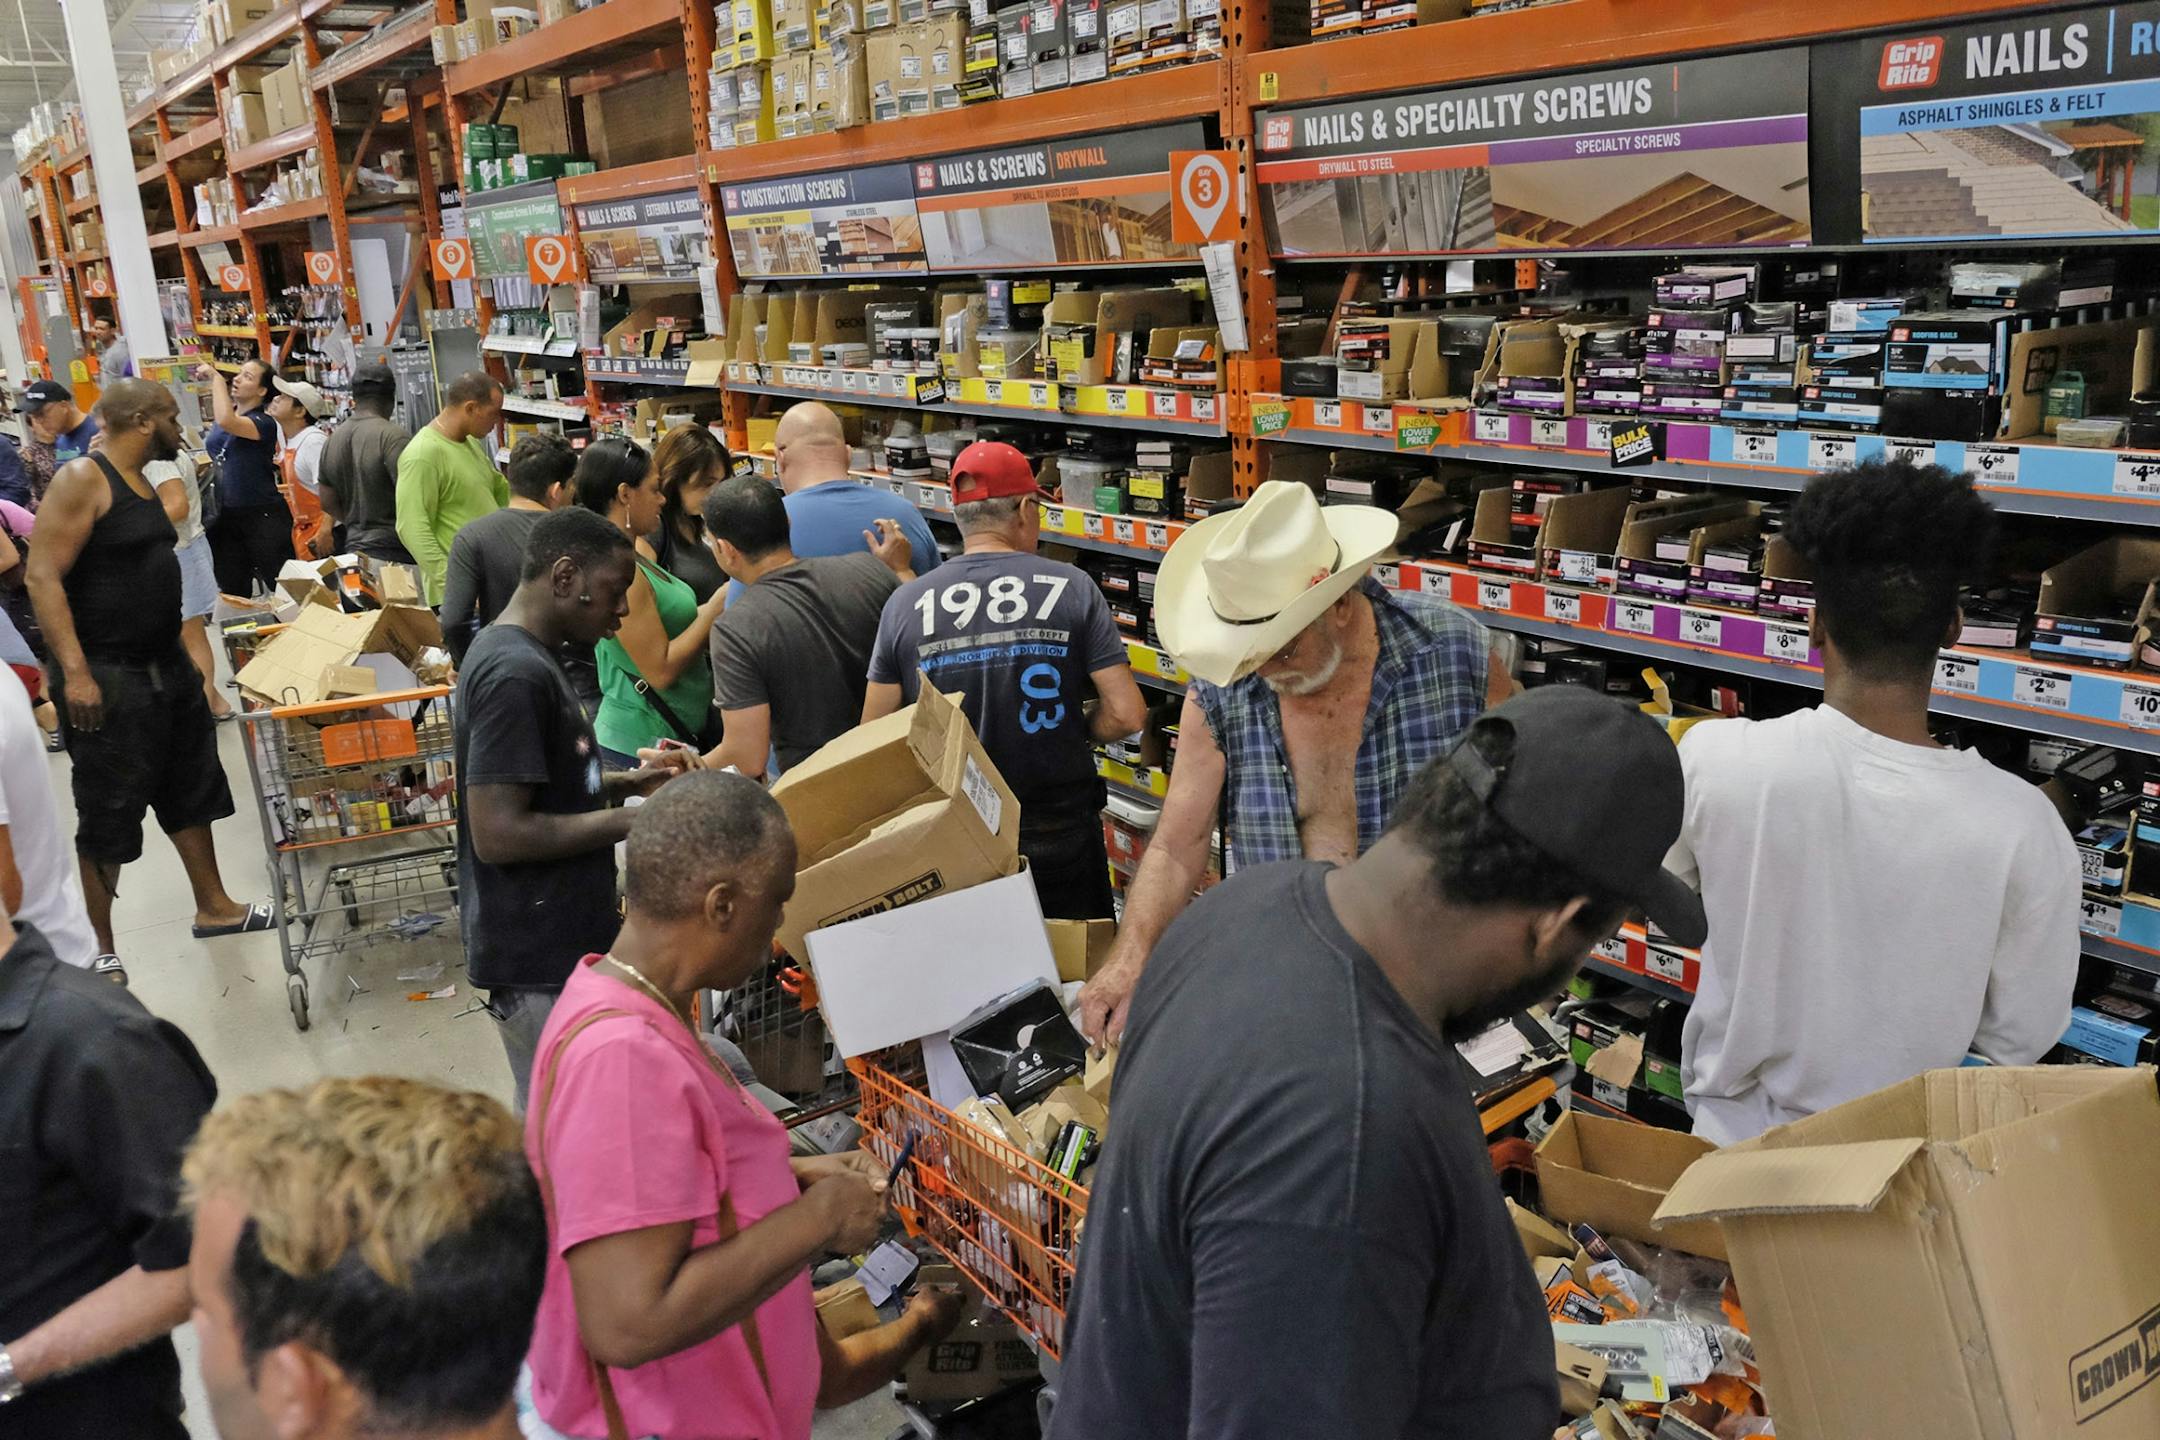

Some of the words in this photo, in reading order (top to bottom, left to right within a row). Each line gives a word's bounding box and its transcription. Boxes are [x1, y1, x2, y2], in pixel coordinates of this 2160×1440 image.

[1889, 42, 1935, 64] Grip
[1966, 23, 2088, 79] NAILS
[1886, 64, 1930, 86] Rite
[1304, 111, 1364, 146] NAILS
[1371, 108, 1388, 139] &
[1395, 92, 1525, 138] SPECIALTY
[1533, 77, 1653, 120] SCREWS
[1898, 106, 1964, 127] ASPHALT
[1968, 98, 2044, 121] SHINGLES
[2049, 97, 2062, 114] &
[2067, 92, 2106, 111] FELT
[1266, 119, 1290, 136] Grip
[1575, 136, 1632, 155] SPECIALTY
[1633, 132, 1681, 150] SCREWS
[939, 163, 975, 187] NAILS
[977, 162, 988, 181] &
[990, 151, 1047, 180] SCREWS
[1056, 147, 1108, 170] DRYWALL
[1318, 160, 1356, 175] DRYWALL
[1357, 159, 1368, 171] TO
[1370, 157, 1395, 171] STEEL
[741, 183, 804, 208] CONSTRUCTION
[806, 178, 847, 201] SCREWS
[1198, 179, 1212, 201] 3
[545, 251, 553, 262] 7
[1257, 413, 1284, 425] LOWER
[1258, 406, 1280, 414] NEW
[1261, 421, 1282, 431] PRICE
[1402, 426, 1433, 439] LOWER
[1405, 418, 1430, 426] NEW
[1406, 435, 1429, 446] PRICE
[1612, 425, 1649, 449] BULK
[1615, 436, 1652, 459] PRICE
[914, 574, 1069, 636] 1987
[893, 877, 934, 906] BOLT
[2077, 1339, 2142, 1404] CROWN
